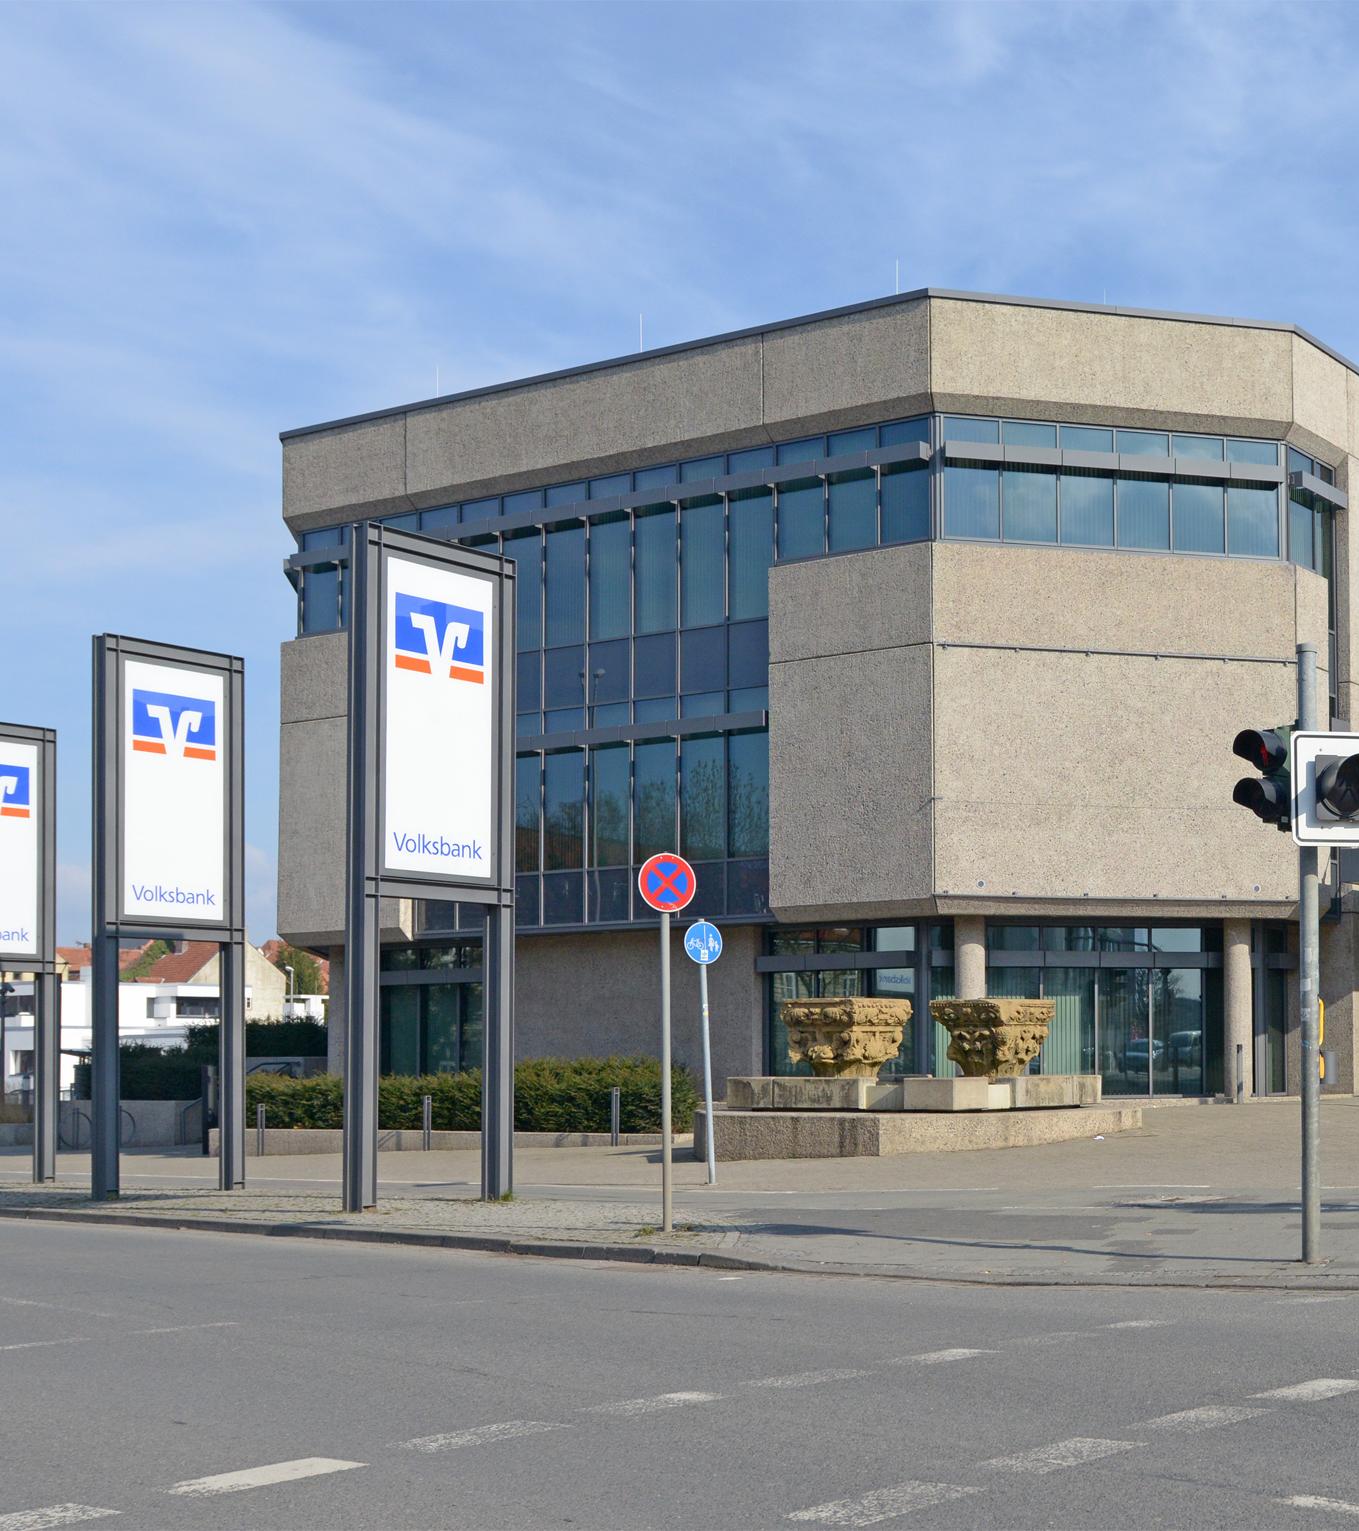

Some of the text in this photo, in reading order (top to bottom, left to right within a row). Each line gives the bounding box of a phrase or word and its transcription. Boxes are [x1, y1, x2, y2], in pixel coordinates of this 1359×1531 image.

[393, 831, 482, 860] Volksbank
[132, 884, 216, 906] Volksbank
[0, 927, 30, 942] ank
